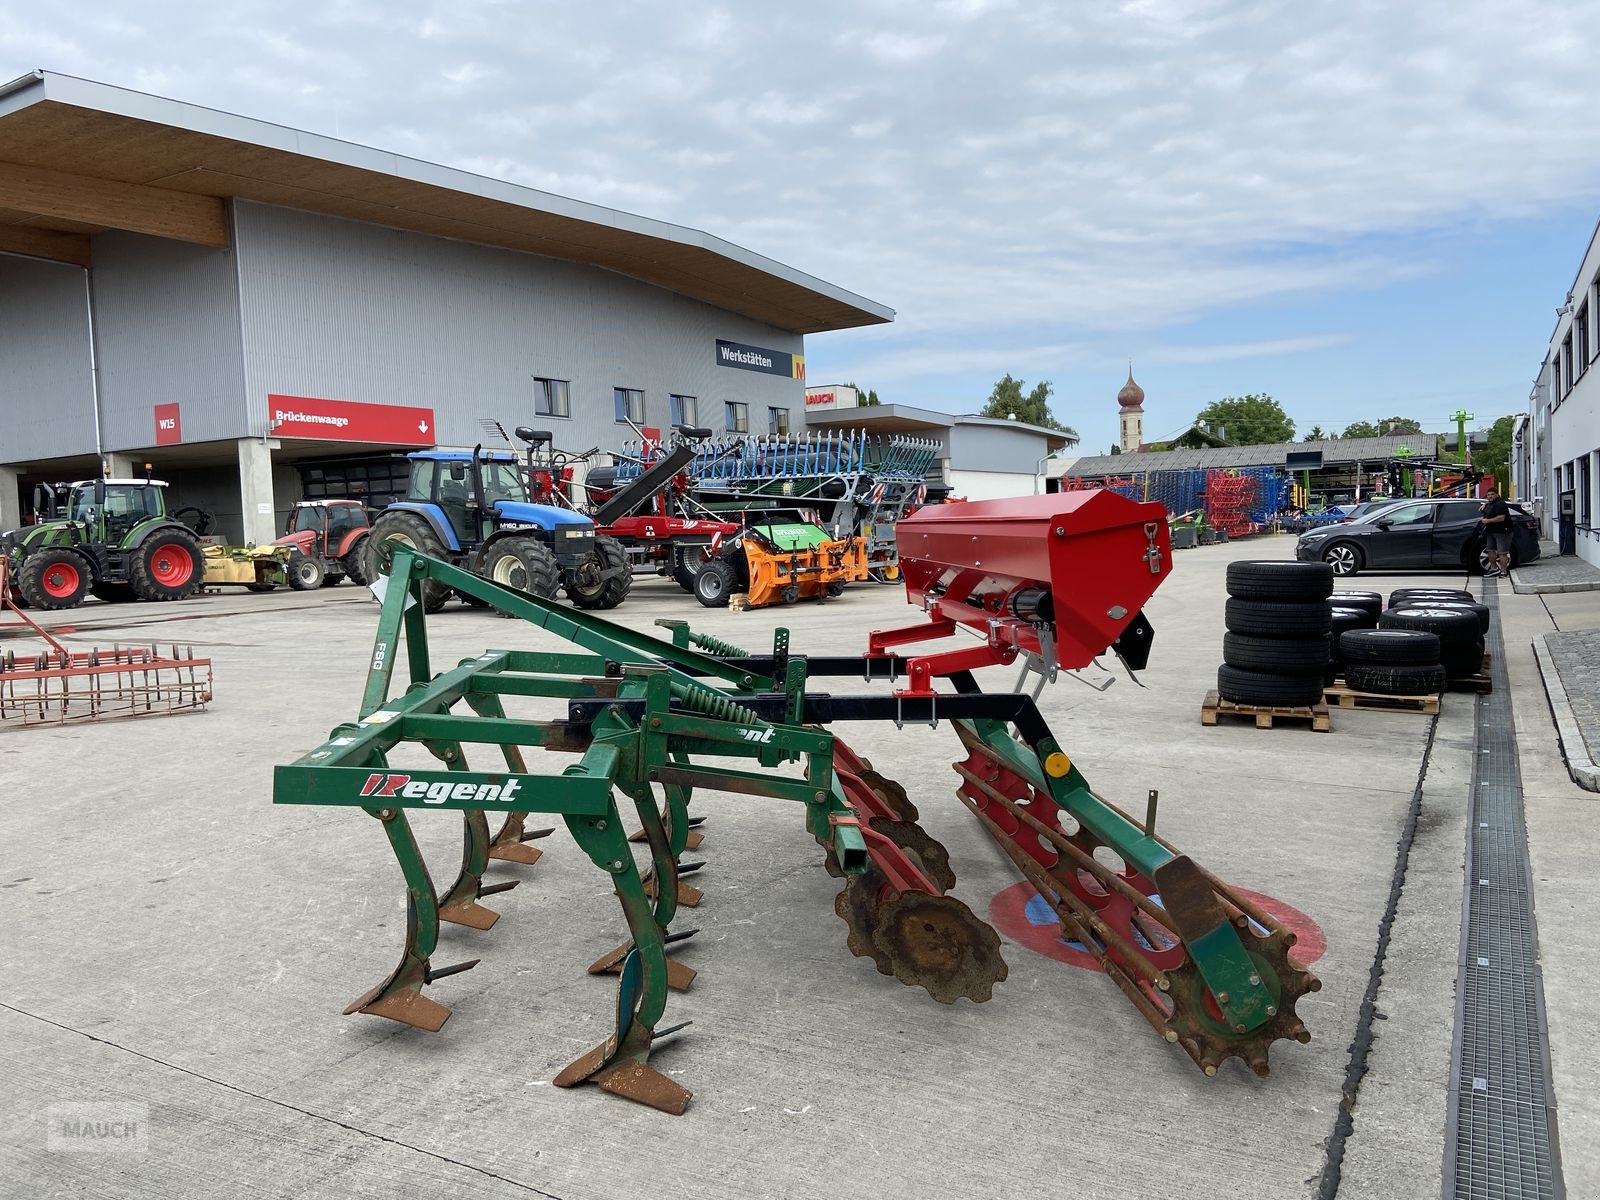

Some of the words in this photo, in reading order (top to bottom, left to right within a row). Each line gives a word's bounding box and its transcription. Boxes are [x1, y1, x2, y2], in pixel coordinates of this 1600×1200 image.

[721, 346, 772, 368] Werkstätten
[160, 418, 175, 430] W15
[275, 410, 349, 427] Brückenwaage
[360, 773, 522, 804] Regent
